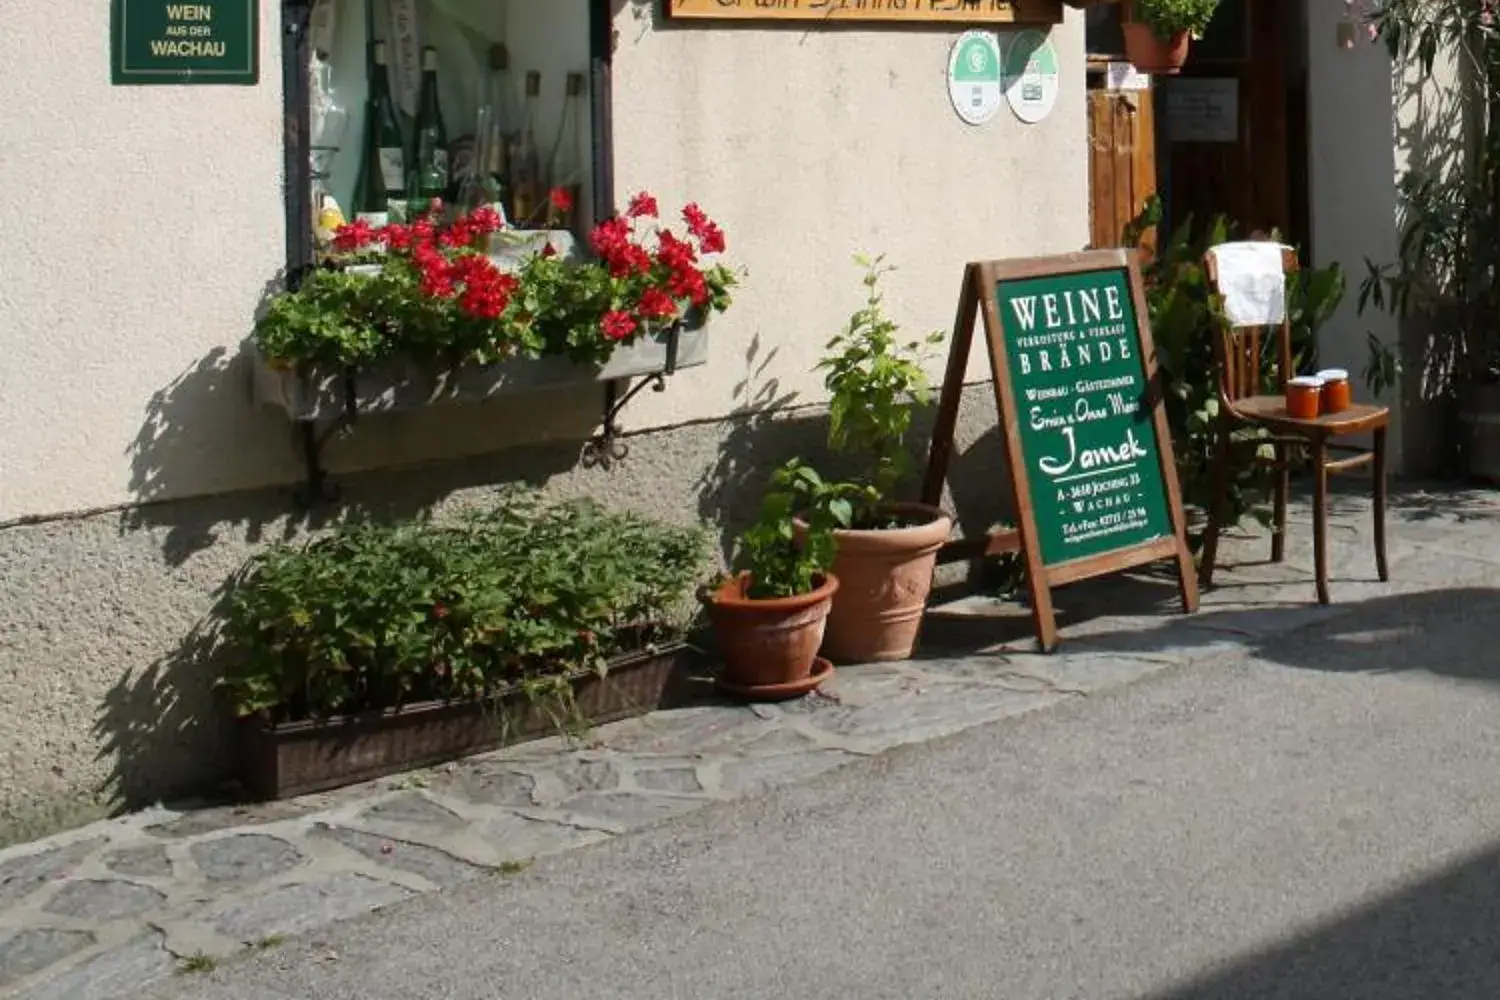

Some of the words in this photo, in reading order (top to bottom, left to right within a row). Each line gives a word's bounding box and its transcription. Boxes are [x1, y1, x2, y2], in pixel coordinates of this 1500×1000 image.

[166, 4, 211, 21] WEIN
[166, 25, 187, 37] AUS
[189, 25, 211, 37] DER
[150, 40, 226, 57] WACHAU
[1010, 286, 1123, 331] WEINE
[1019, 338, 1131, 375] BRÄNDE
[1040, 427, 1147, 475] Jamek
